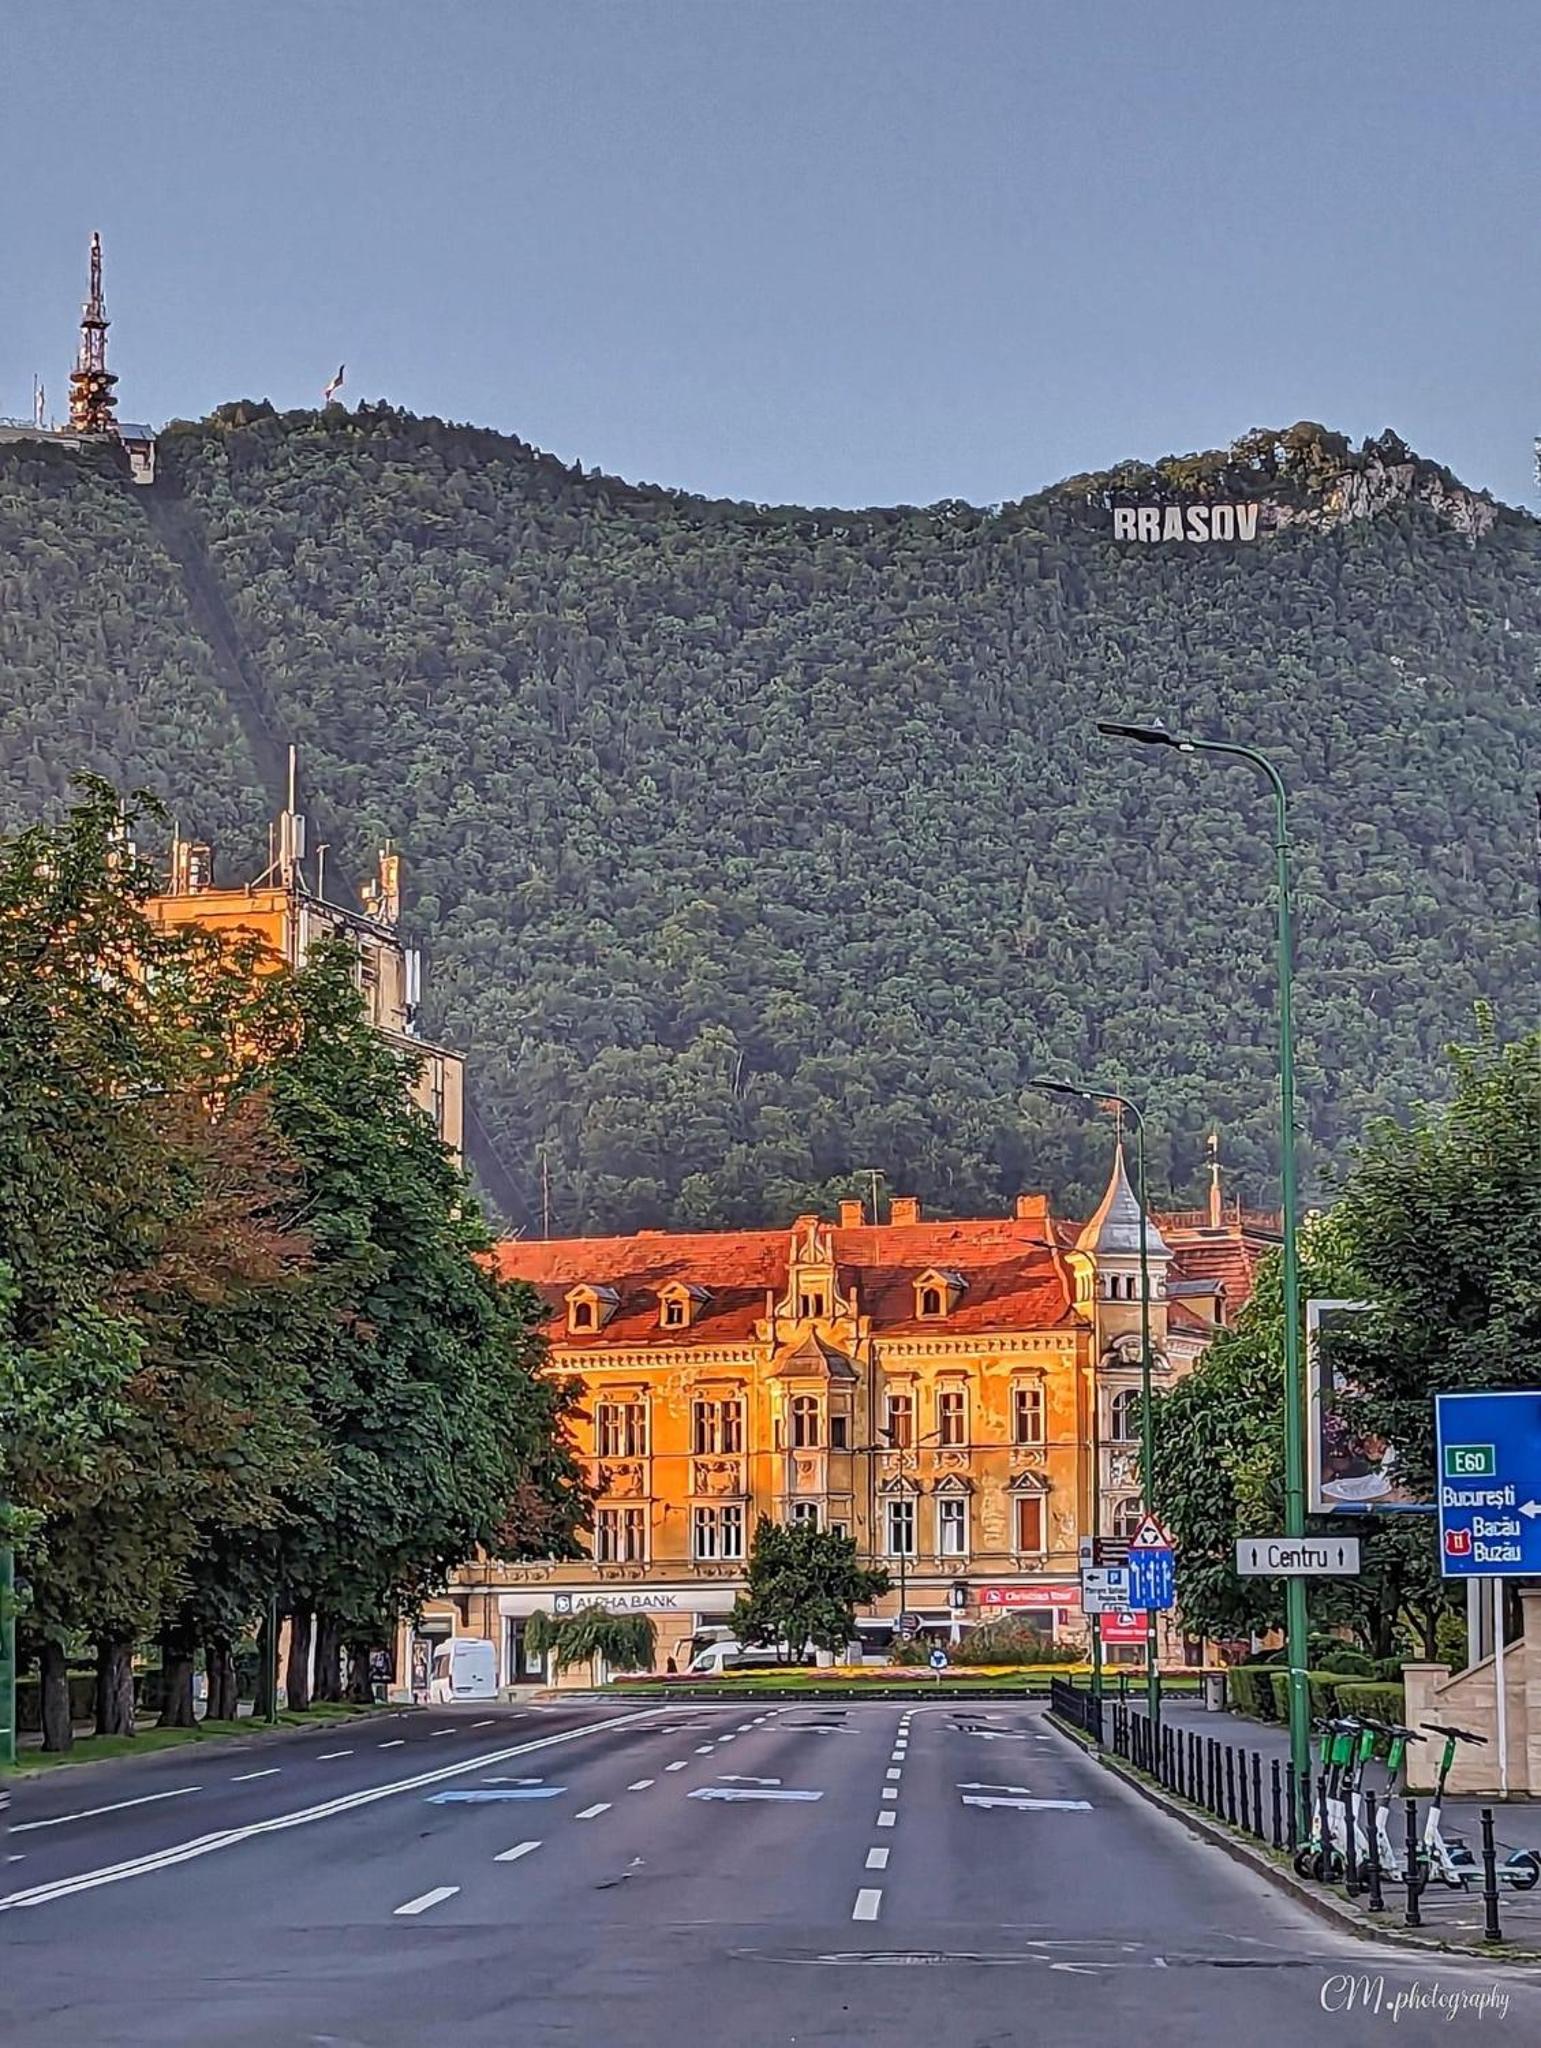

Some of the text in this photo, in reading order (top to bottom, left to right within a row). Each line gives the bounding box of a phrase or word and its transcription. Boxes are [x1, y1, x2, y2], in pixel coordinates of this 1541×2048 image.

[1455, 1451, 1485, 1472] E60
[1443, 1485, 1515, 1510] București
[1472, 1516, 1520, 1537] Bacău
[1268, 1545, 1327, 1568] Centru
[1473, 1541, 1521, 1562] Buzău
[631, 1595, 678, 1608] BANK
